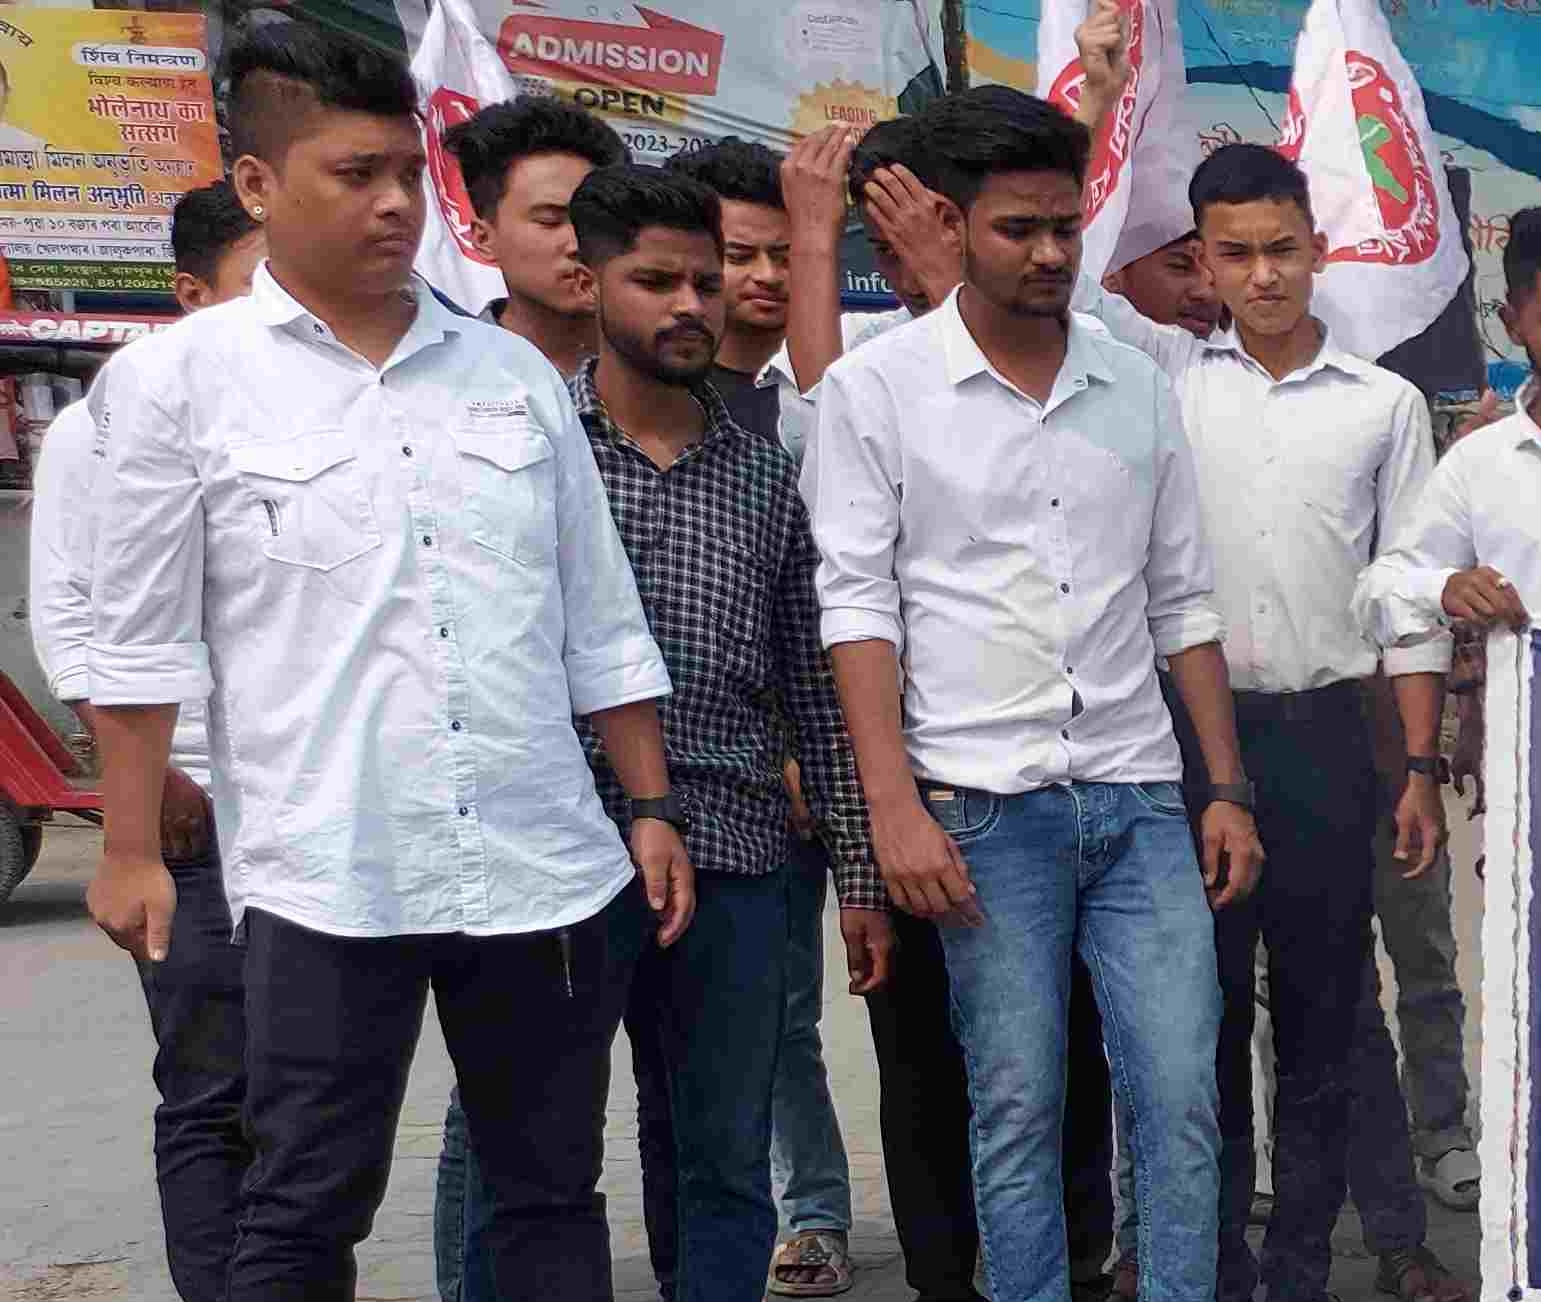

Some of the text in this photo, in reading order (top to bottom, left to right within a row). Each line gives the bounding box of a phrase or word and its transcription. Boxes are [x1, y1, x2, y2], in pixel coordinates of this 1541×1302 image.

[81, 46, 120, 64] शिव
[510, 32, 709, 77] ADMISSION
[88, 94, 206, 120] भोलेनाथ का
[573, 88, 666, 117] OPEN
[823, 104, 878, 125] LEADING
[33, 180, 80, 202] मिलन
